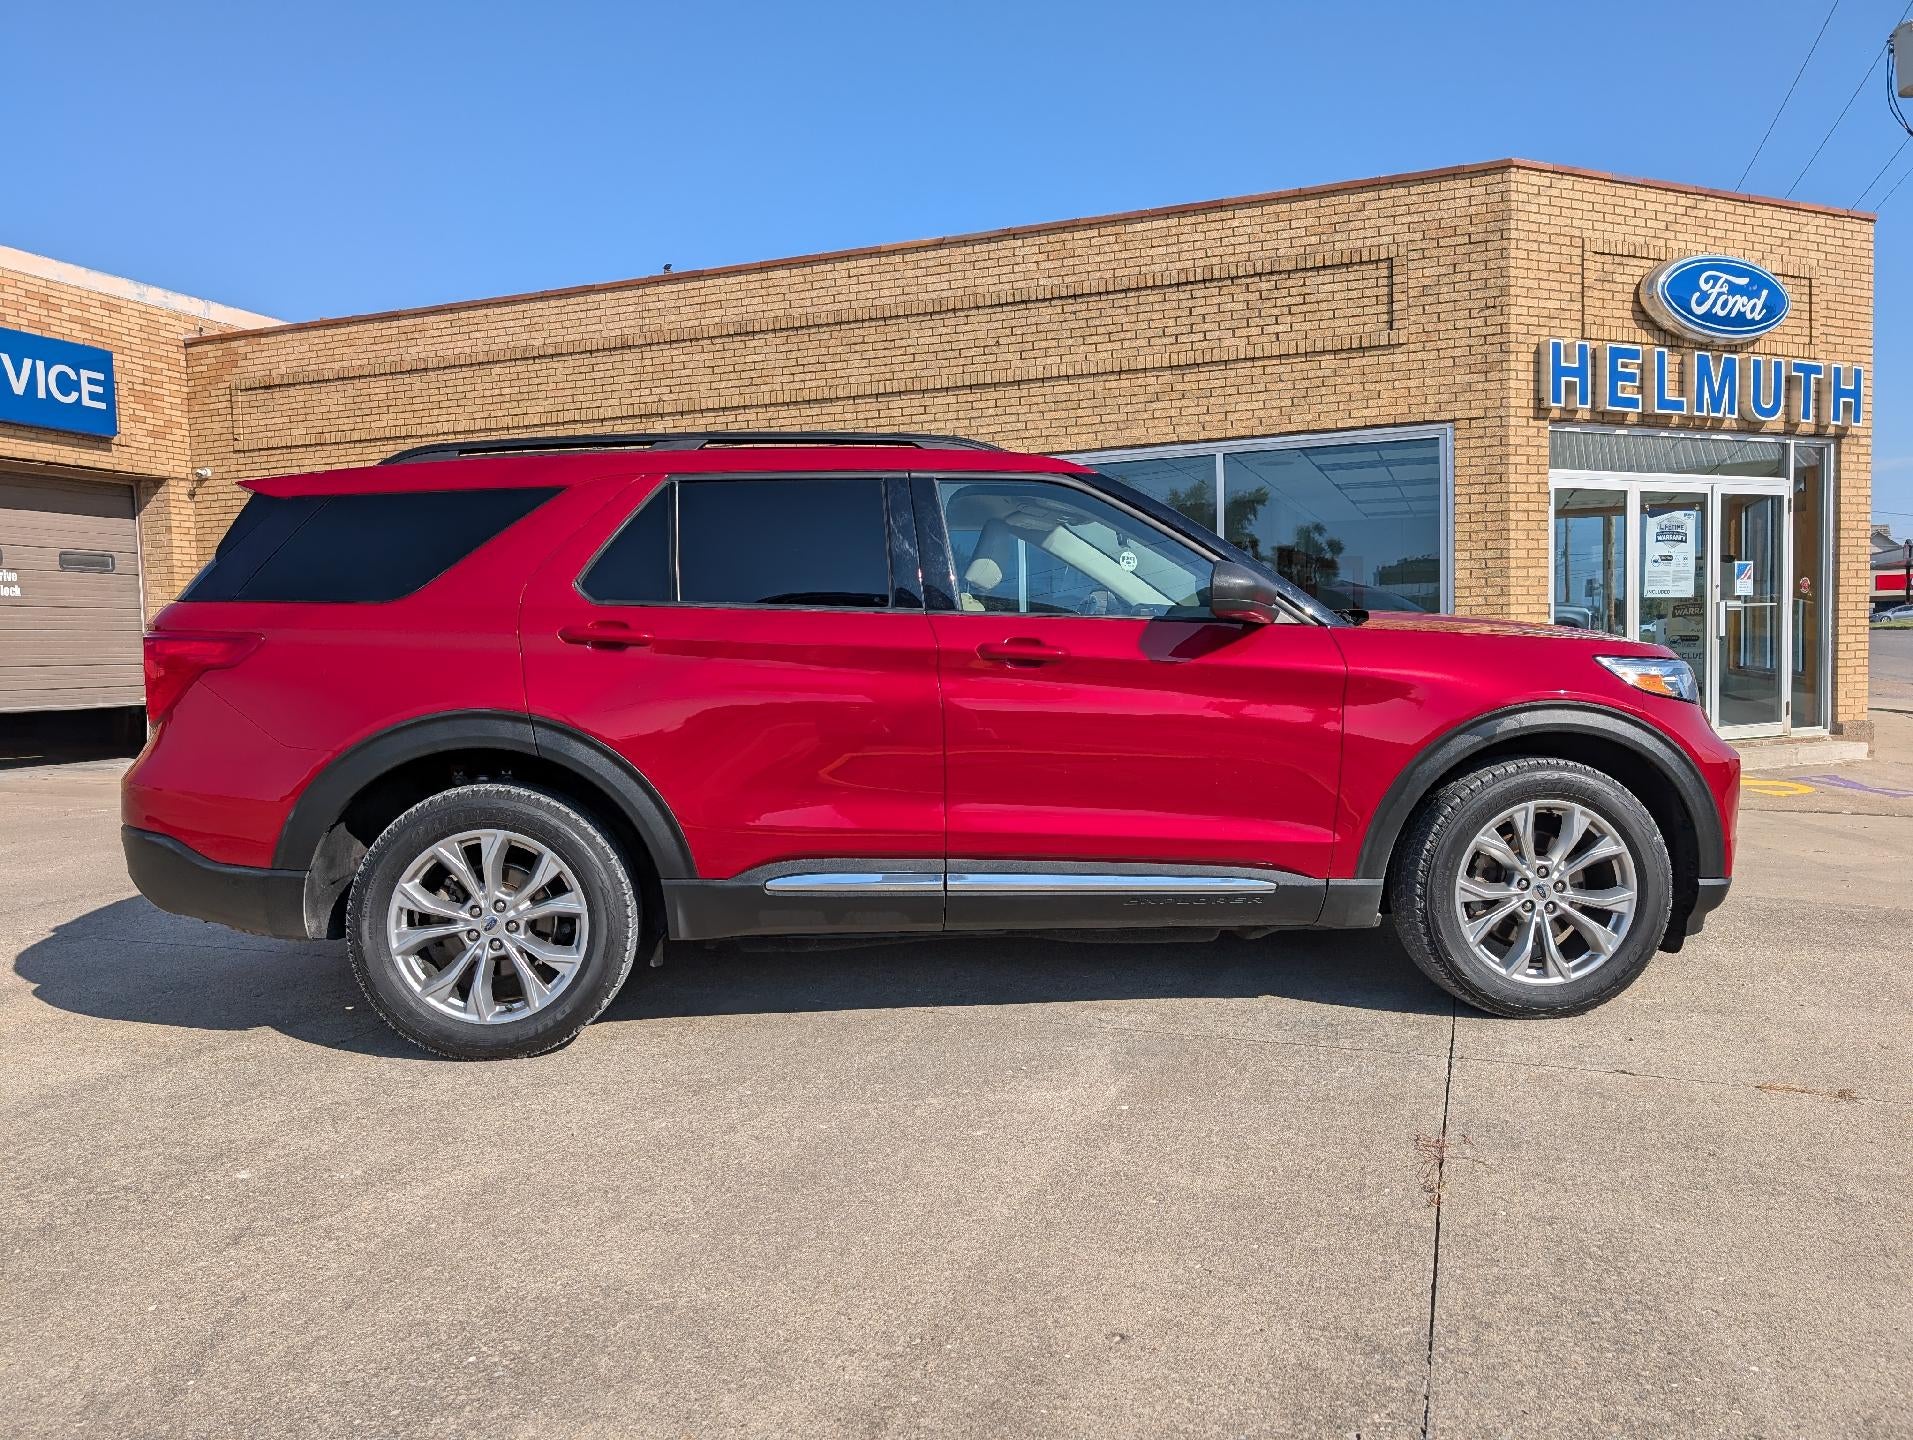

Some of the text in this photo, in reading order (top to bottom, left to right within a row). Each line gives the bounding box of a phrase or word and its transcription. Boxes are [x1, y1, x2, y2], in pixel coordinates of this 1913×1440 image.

[1690, 270, 1769, 321] Ford
[0, 353, 107, 410] VICE
[1548, 338, 1865, 427] HELMUTH
[1656, 534, 1686, 542] WARRANTY
